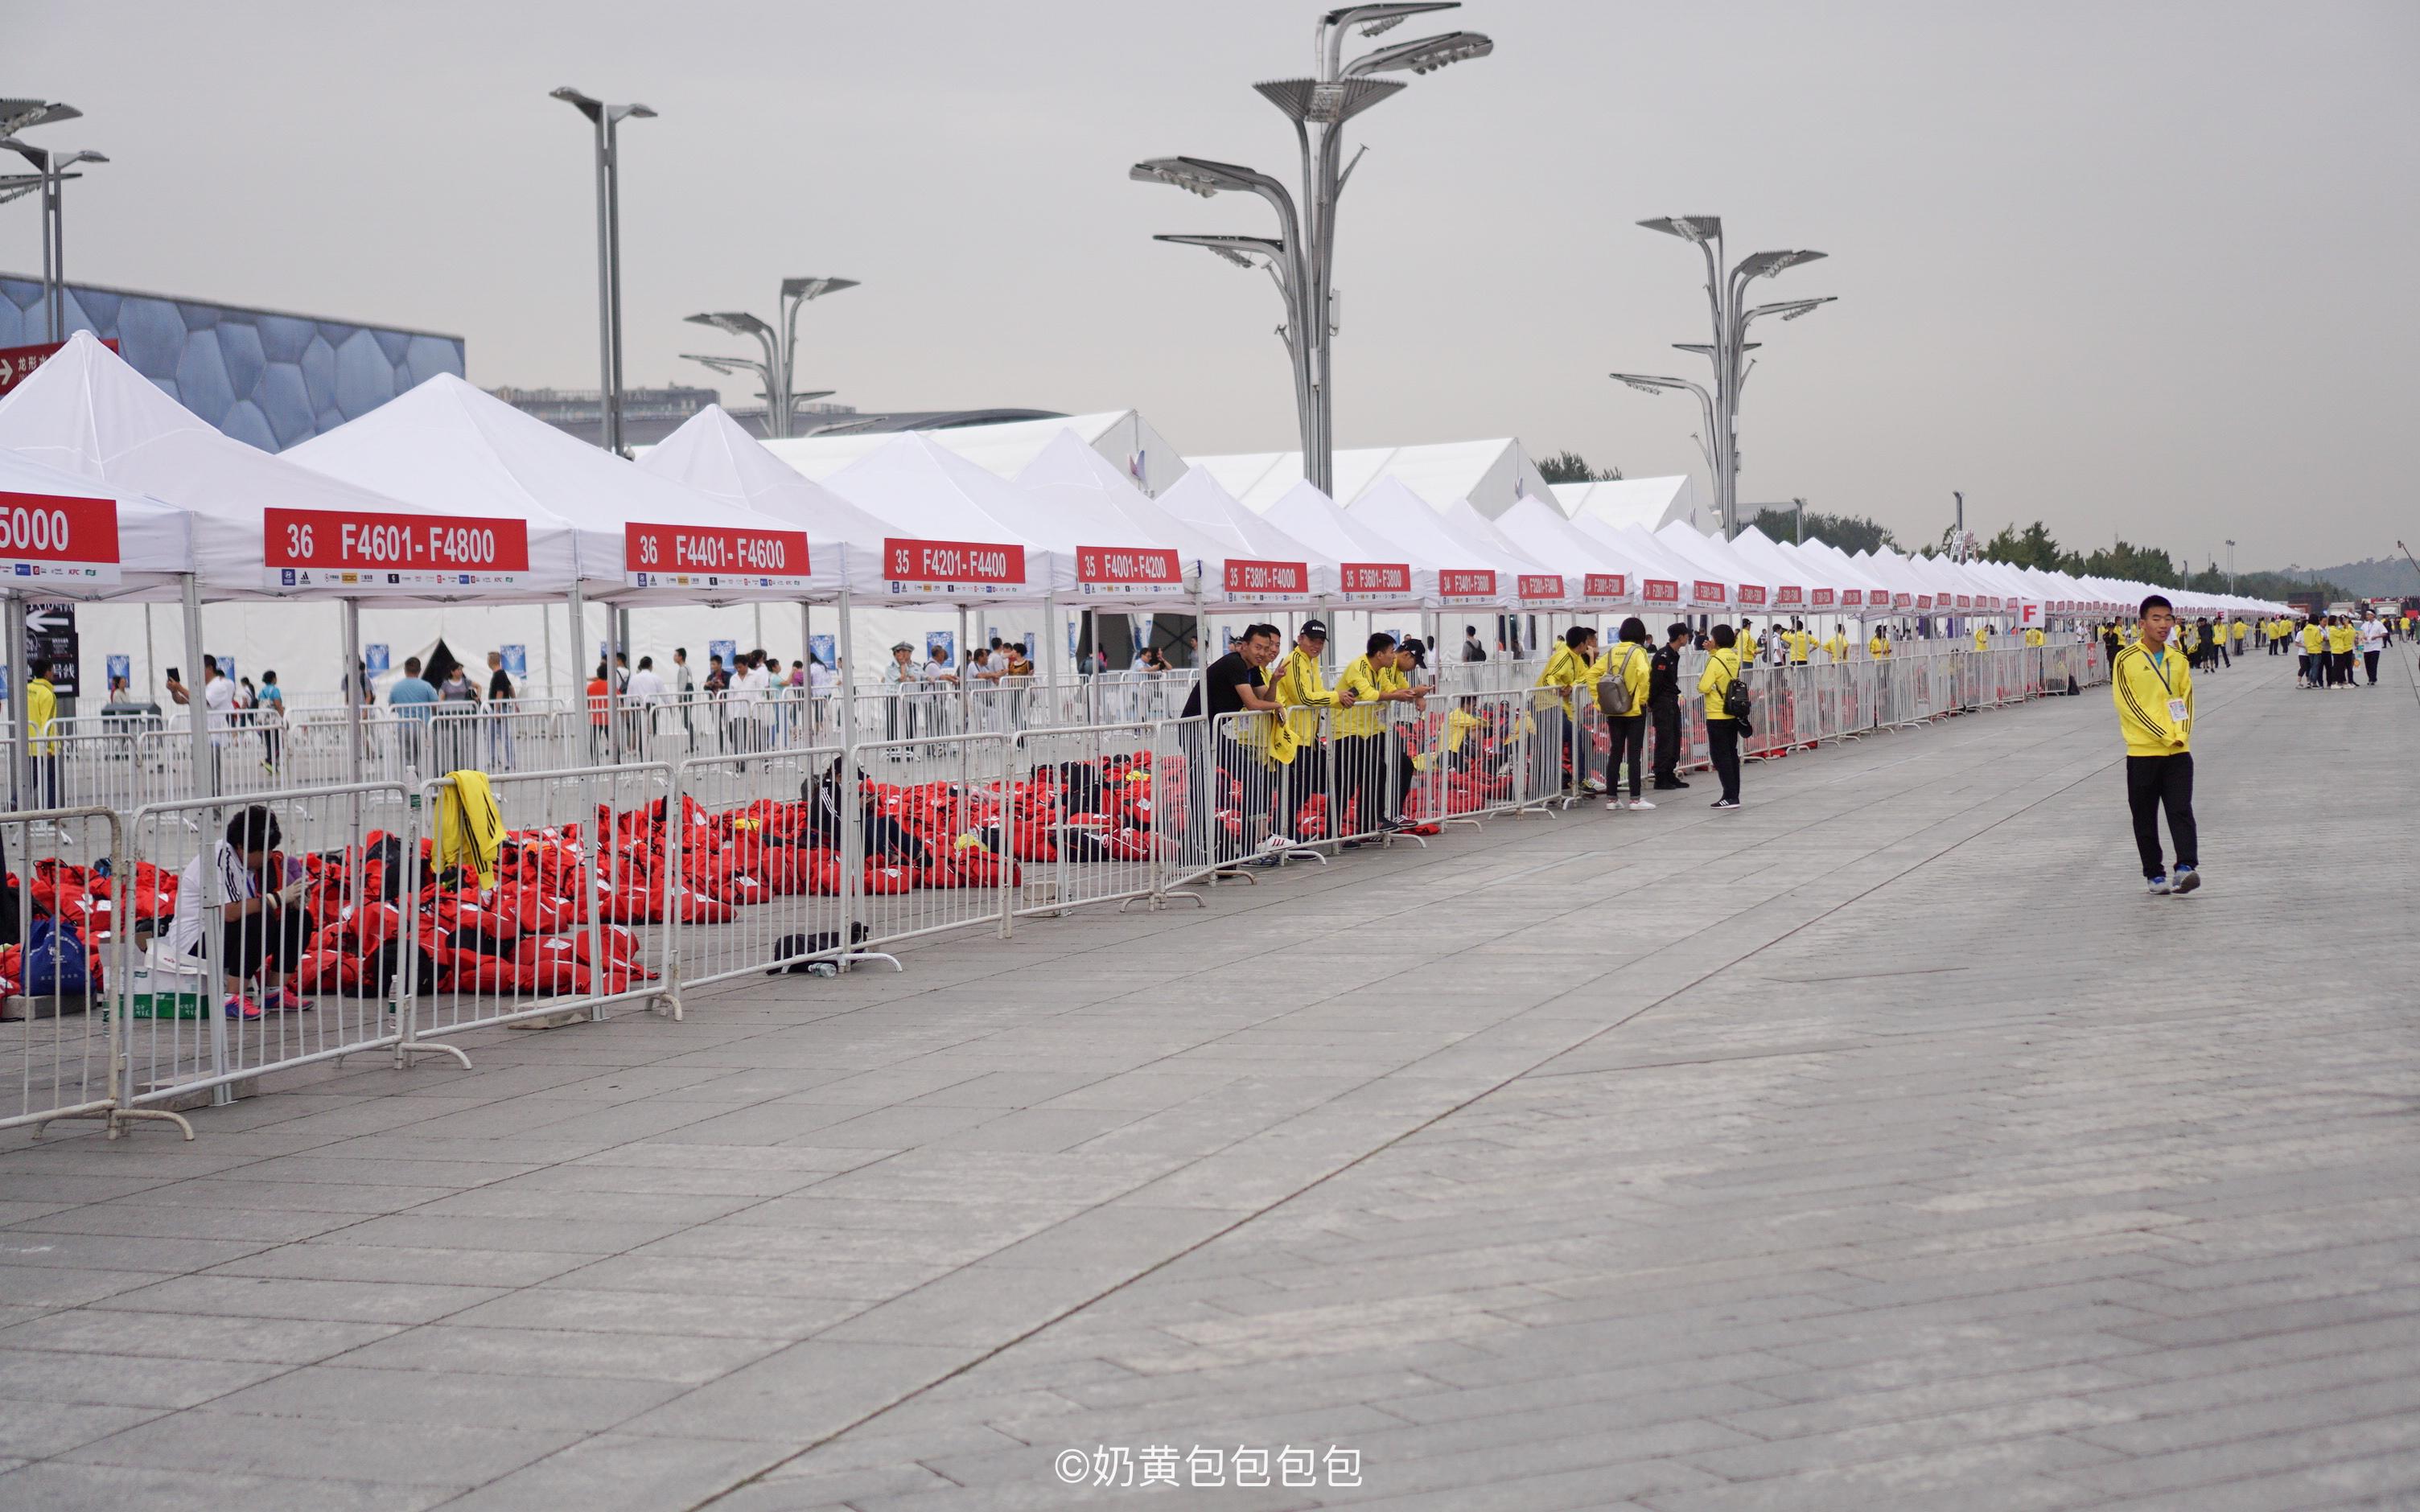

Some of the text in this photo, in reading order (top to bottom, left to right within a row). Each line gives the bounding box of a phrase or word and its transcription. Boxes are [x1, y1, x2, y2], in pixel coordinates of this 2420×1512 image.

[0, 507, 68, 552] 5000
[286, 524, 314, 558] 36
[640, 535, 658, 565] 36
[895, 549, 909, 574] 35
[1084, 555, 1096, 577] 35
[1229, 567, 1238, 585] 35
[1346, 569, 1353, 587] 35
[1444, 577, 1451, 592] 34
[2023, 605, 2037, 622] F
[2217, 611, 2224, 619] E
